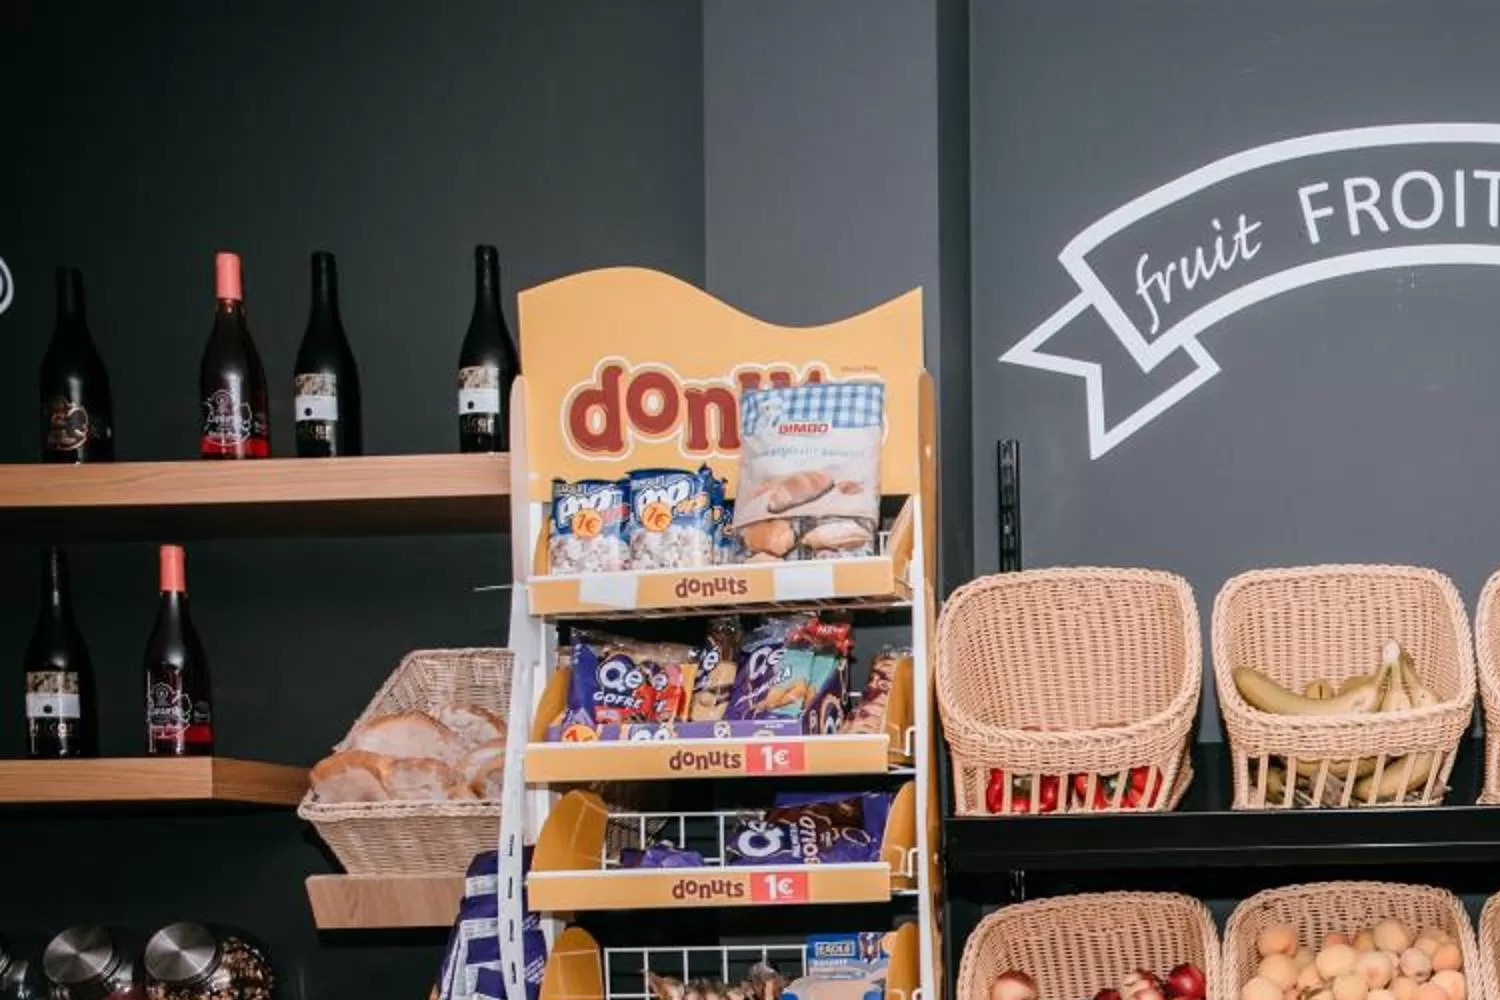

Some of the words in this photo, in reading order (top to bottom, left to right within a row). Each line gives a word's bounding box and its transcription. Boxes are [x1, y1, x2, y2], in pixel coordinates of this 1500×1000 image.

[1134, 213, 1263, 334] fruit
[569, 365, 822, 453] don
[675, 577, 748, 598] donuts
[669, 749, 741, 771] donuts
[760, 746, 790, 770] 1€
[672, 879, 744, 899] donuts
[764, 874, 794, 900] 1€
